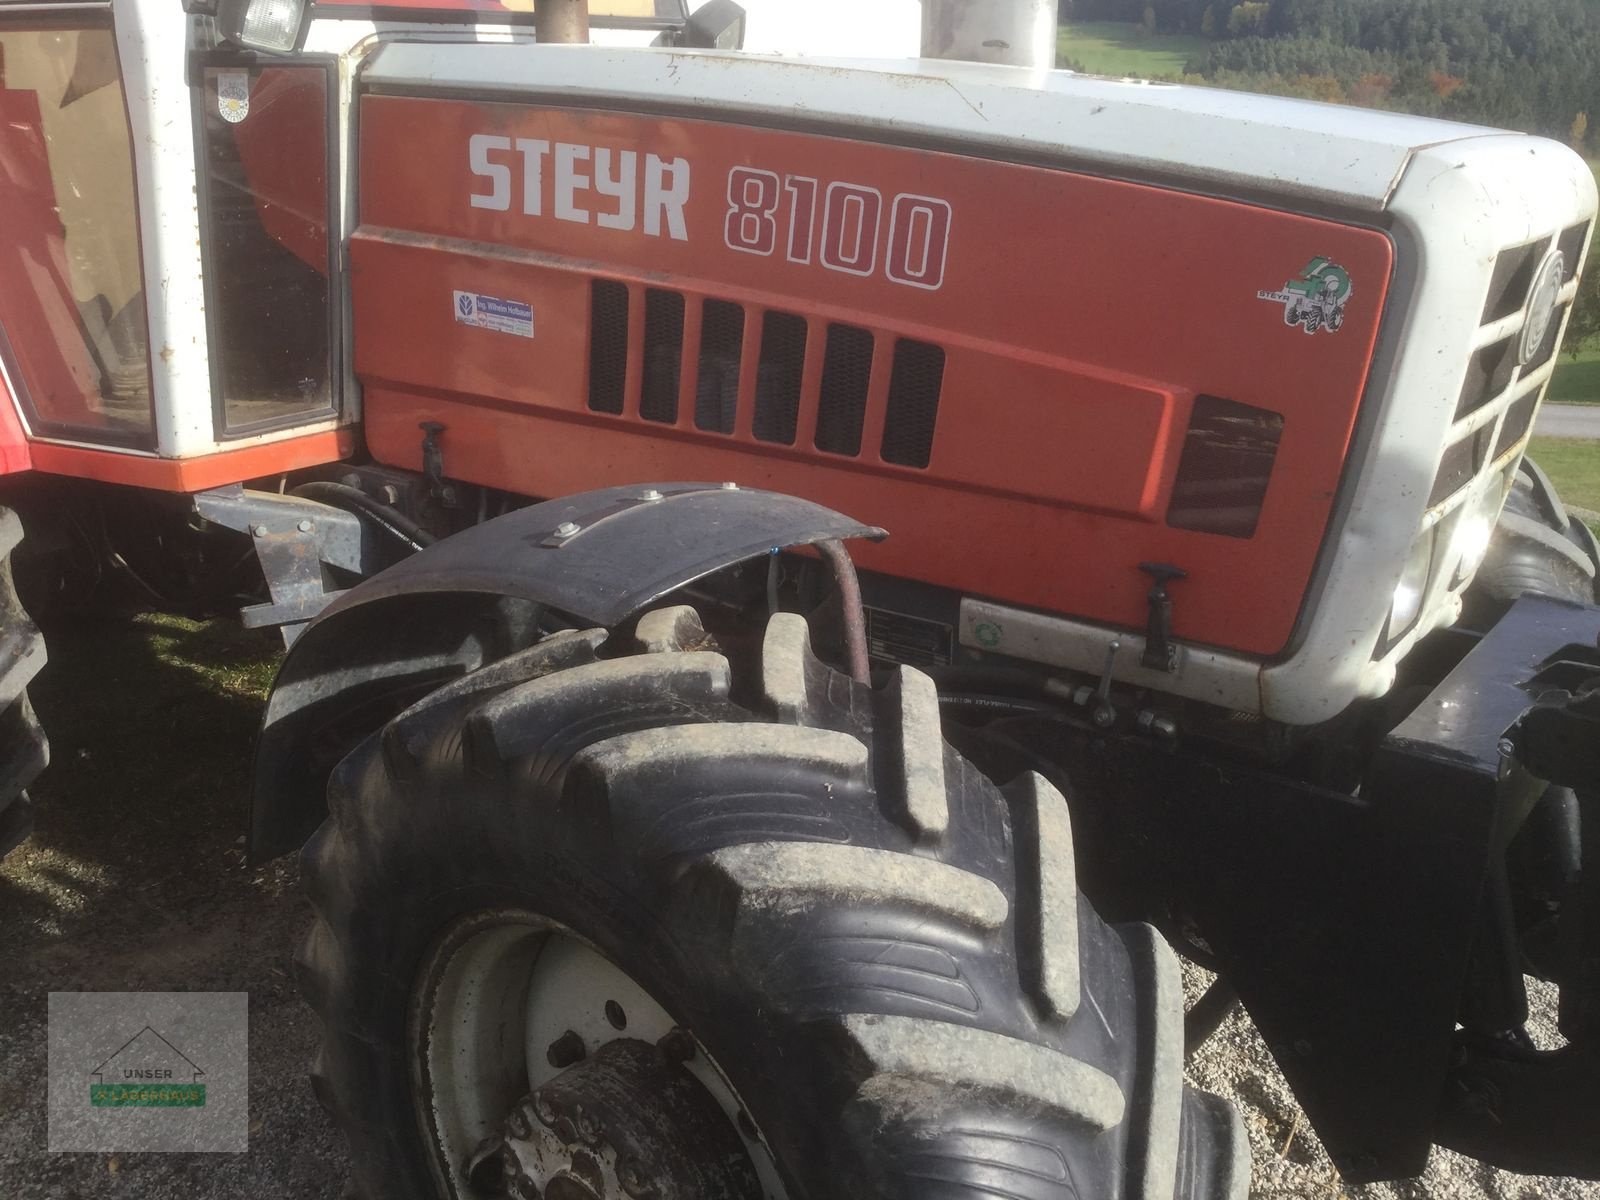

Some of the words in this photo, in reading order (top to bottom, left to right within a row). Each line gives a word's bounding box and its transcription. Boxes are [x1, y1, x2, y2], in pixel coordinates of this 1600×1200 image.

[469, 134, 691, 242] STEYR
[724, 165, 952, 290] 8100
[1258, 291, 1290, 301] STEYR
